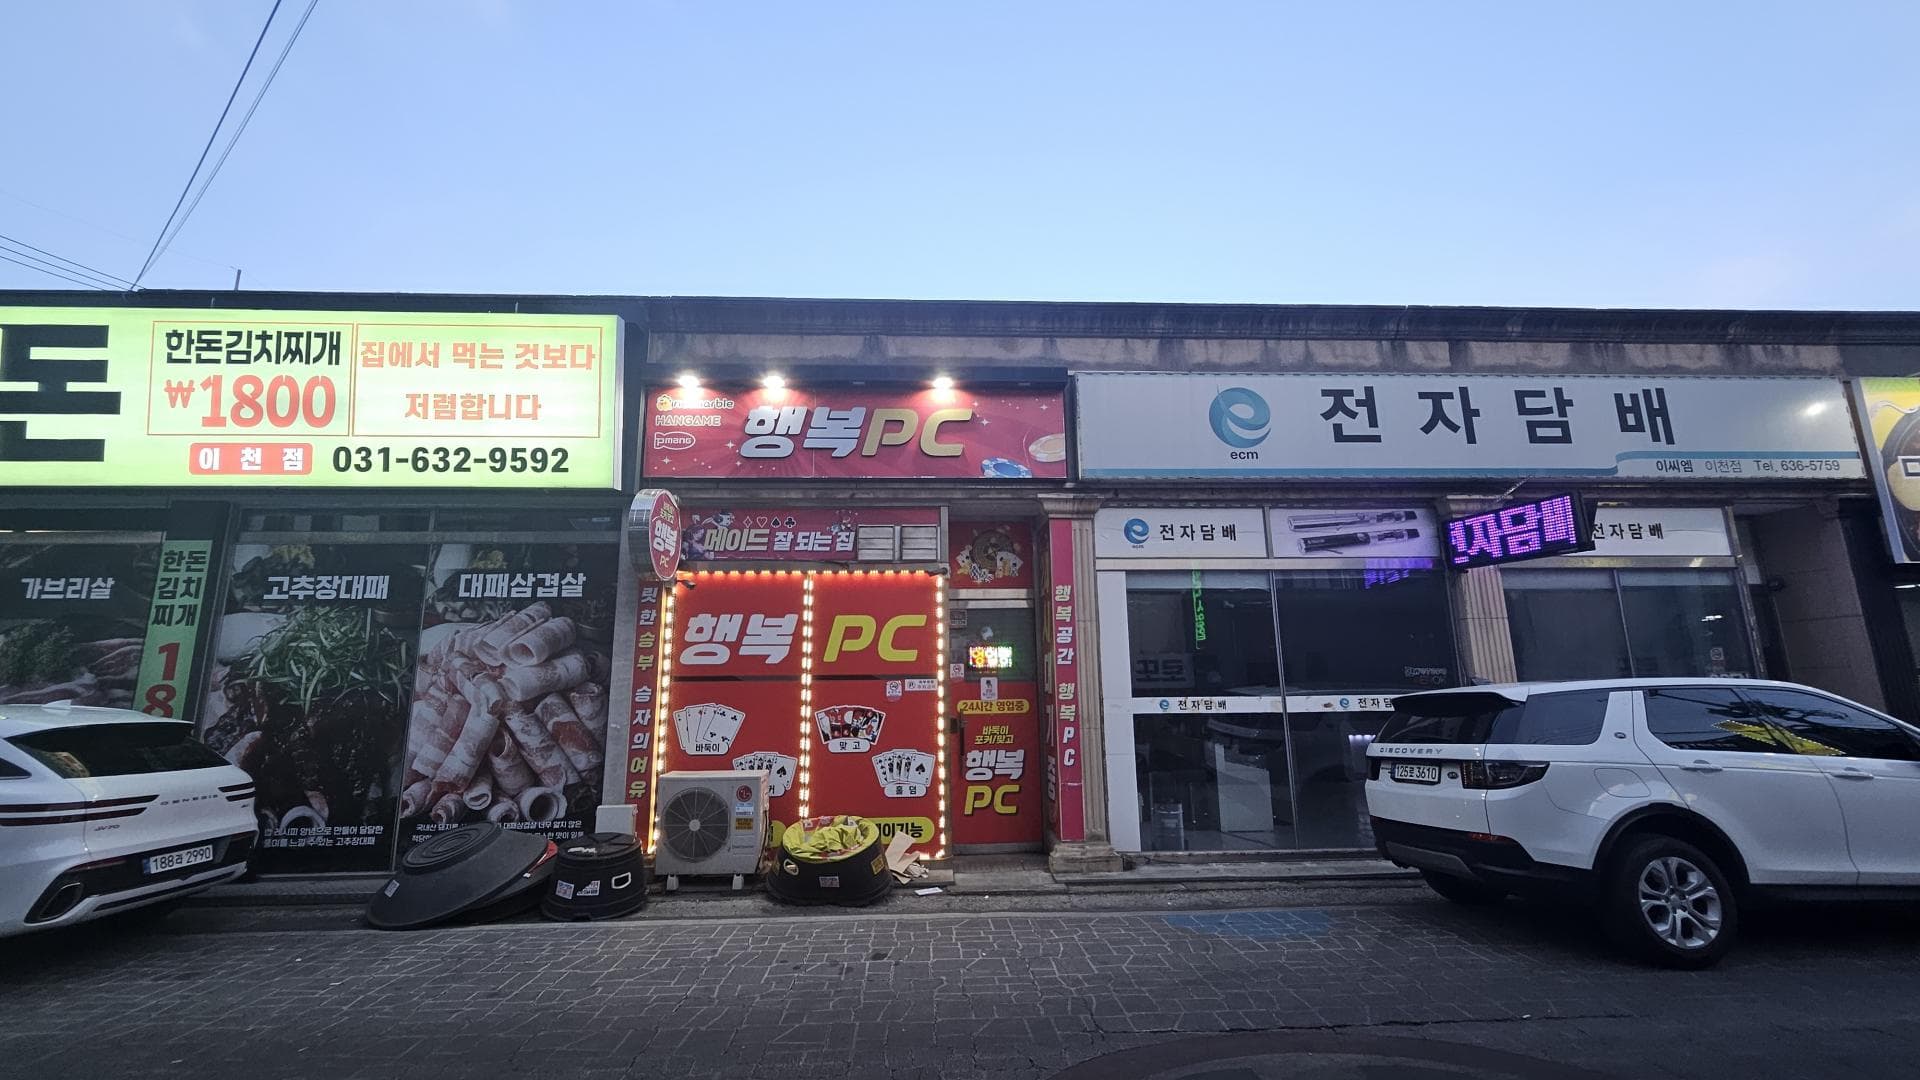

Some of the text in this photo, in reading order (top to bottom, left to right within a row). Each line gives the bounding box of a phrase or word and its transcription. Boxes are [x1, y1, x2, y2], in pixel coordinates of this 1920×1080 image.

[165, 329, 342, 365] 한돈김치찌개
[360, 341, 596, 371] 집에서 먹는 것보다
[405, 393, 542, 421] 저렴합니다
[1319, 385, 1676, 445] 전자담배
[739, 405, 973, 458] 행복PC
[333, 446, 570, 473] 031-632-9592
[1230, 449, 1259, 461] ecm
[1656, 459, 1694, 473] 이씨엠
[1705, 460, 1742, 473] 이천점
[1780, 460, 1841, 472] 636-5759
[652, 520, 678, 558] 행복
[703, 528, 855, 552] 메이드 잘 되는 집
[1159, 523, 1237, 541] 전자담배
[162, 550, 207, 573] 한돈
[21, 577, 115, 600] 가브리살
[157, 577, 202, 600] 김치
[263, 574, 390, 600] 고추장대패
[457, 572, 587, 598] 대패삼겹살
[151, 604, 198, 627] 찌개
[1055, 585, 1074, 665] 행복공간
[679, 612, 928, 665] 행복 PC
[637, 631, 656, 671] 승부
[962, 700, 1025, 712] 24시간 영업중
[1178, 699, 1227, 711] 전자담배
[1357, 698, 1392, 709] 전자담
[631, 685, 652, 749] 승자의
[982, 725, 1009, 736] 바둑이
[695, 742, 721, 753] 바둑이
[838, 741, 861, 751] 맞고
[1379, 747, 1442, 755] DISCOVERY
[965, 749, 1025, 781] 행복
[1416, 766, 1437, 780] 3610
[629, 756, 649, 798] 여유
[895, 785, 917, 795] 홀덤
[964, 784, 1020, 815] PC
[186, 846, 211, 864] 2990
